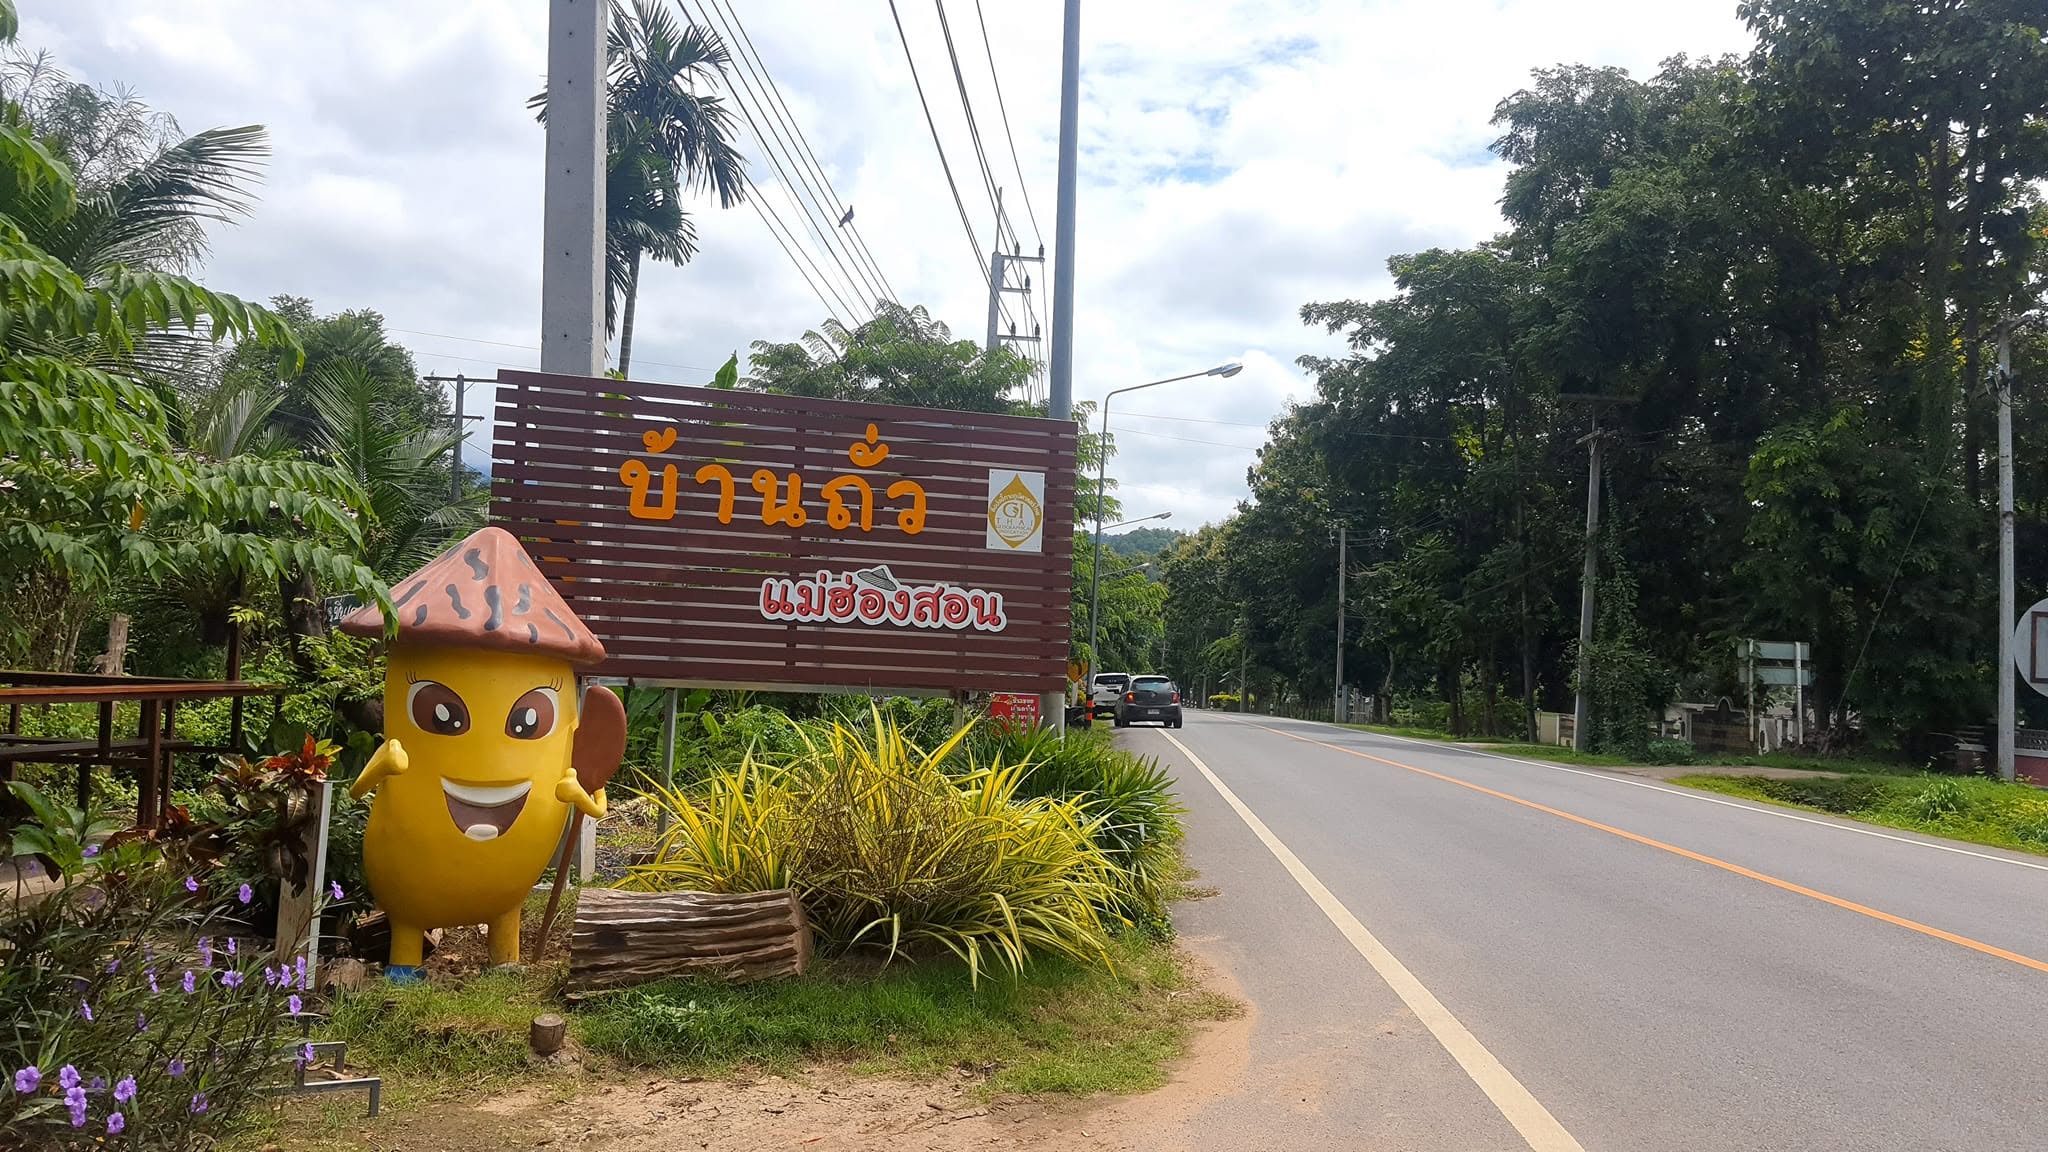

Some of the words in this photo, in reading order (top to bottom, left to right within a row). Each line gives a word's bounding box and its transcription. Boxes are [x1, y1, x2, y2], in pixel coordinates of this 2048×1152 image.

[619, 423, 927, 535] บ้านถั่ว
[997, 518, 1033, 526] THAI
[1003, 502, 1024, 518] GI
[763, 573, 1001, 627] แม่ฮ่องสอน
